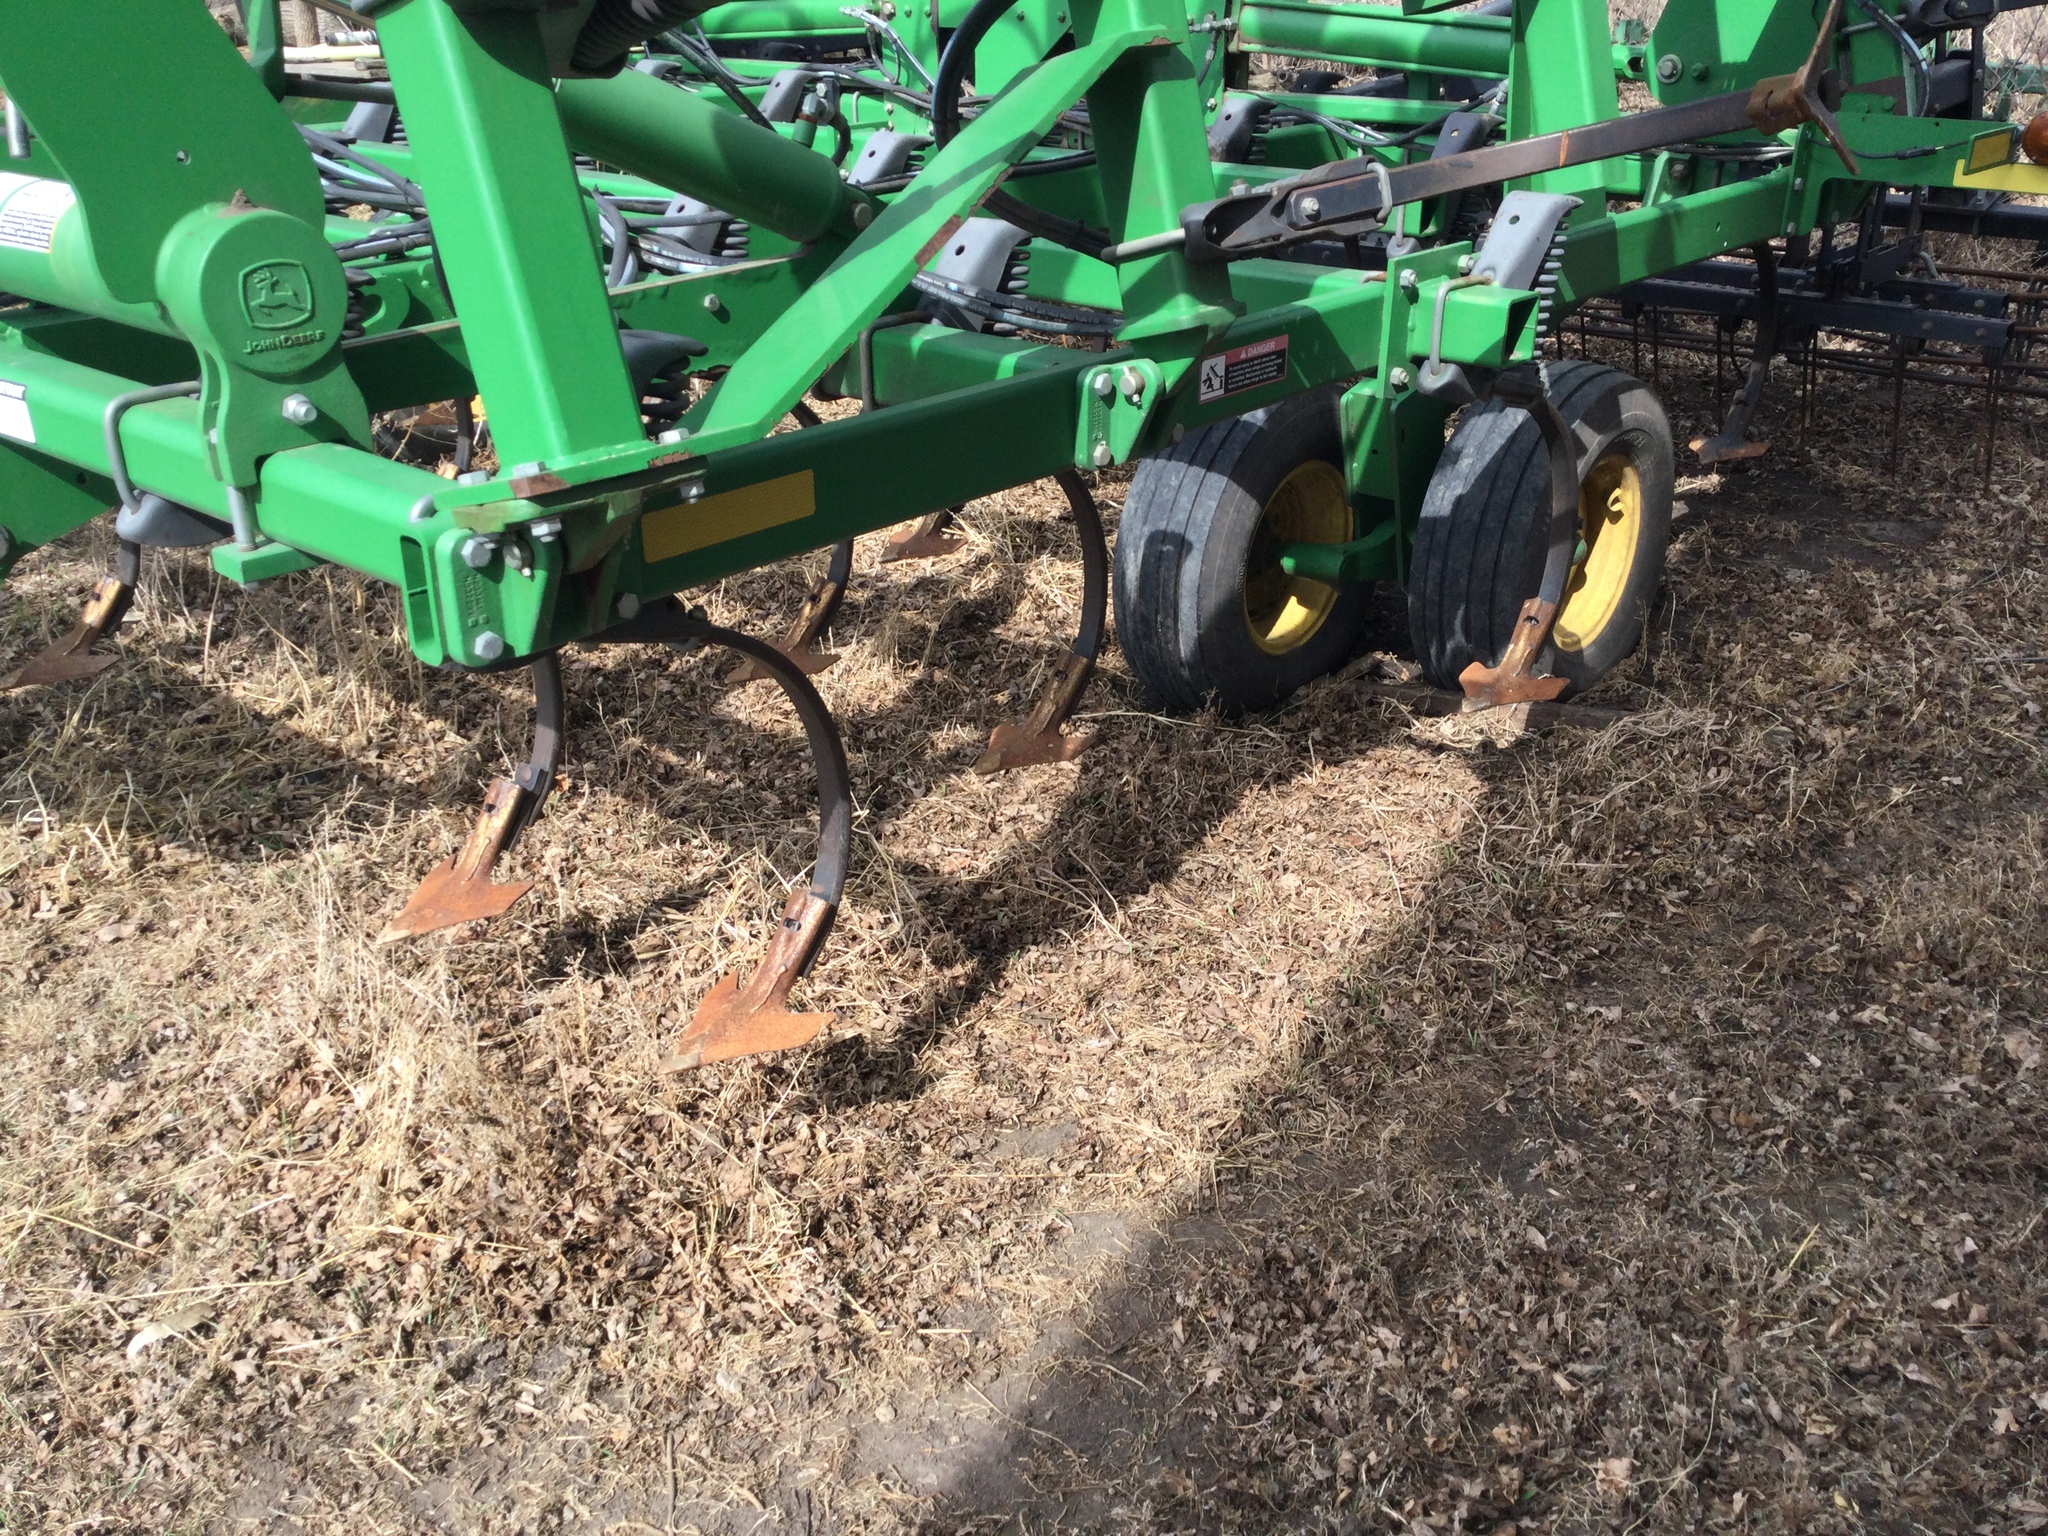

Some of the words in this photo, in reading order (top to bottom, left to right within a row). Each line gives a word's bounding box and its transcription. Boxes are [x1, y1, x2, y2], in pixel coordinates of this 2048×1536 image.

[243, 338, 281, 355] JOHN
[280, 330, 326, 349] DEERE
[1247, 341, 1276, 357] DANGER
